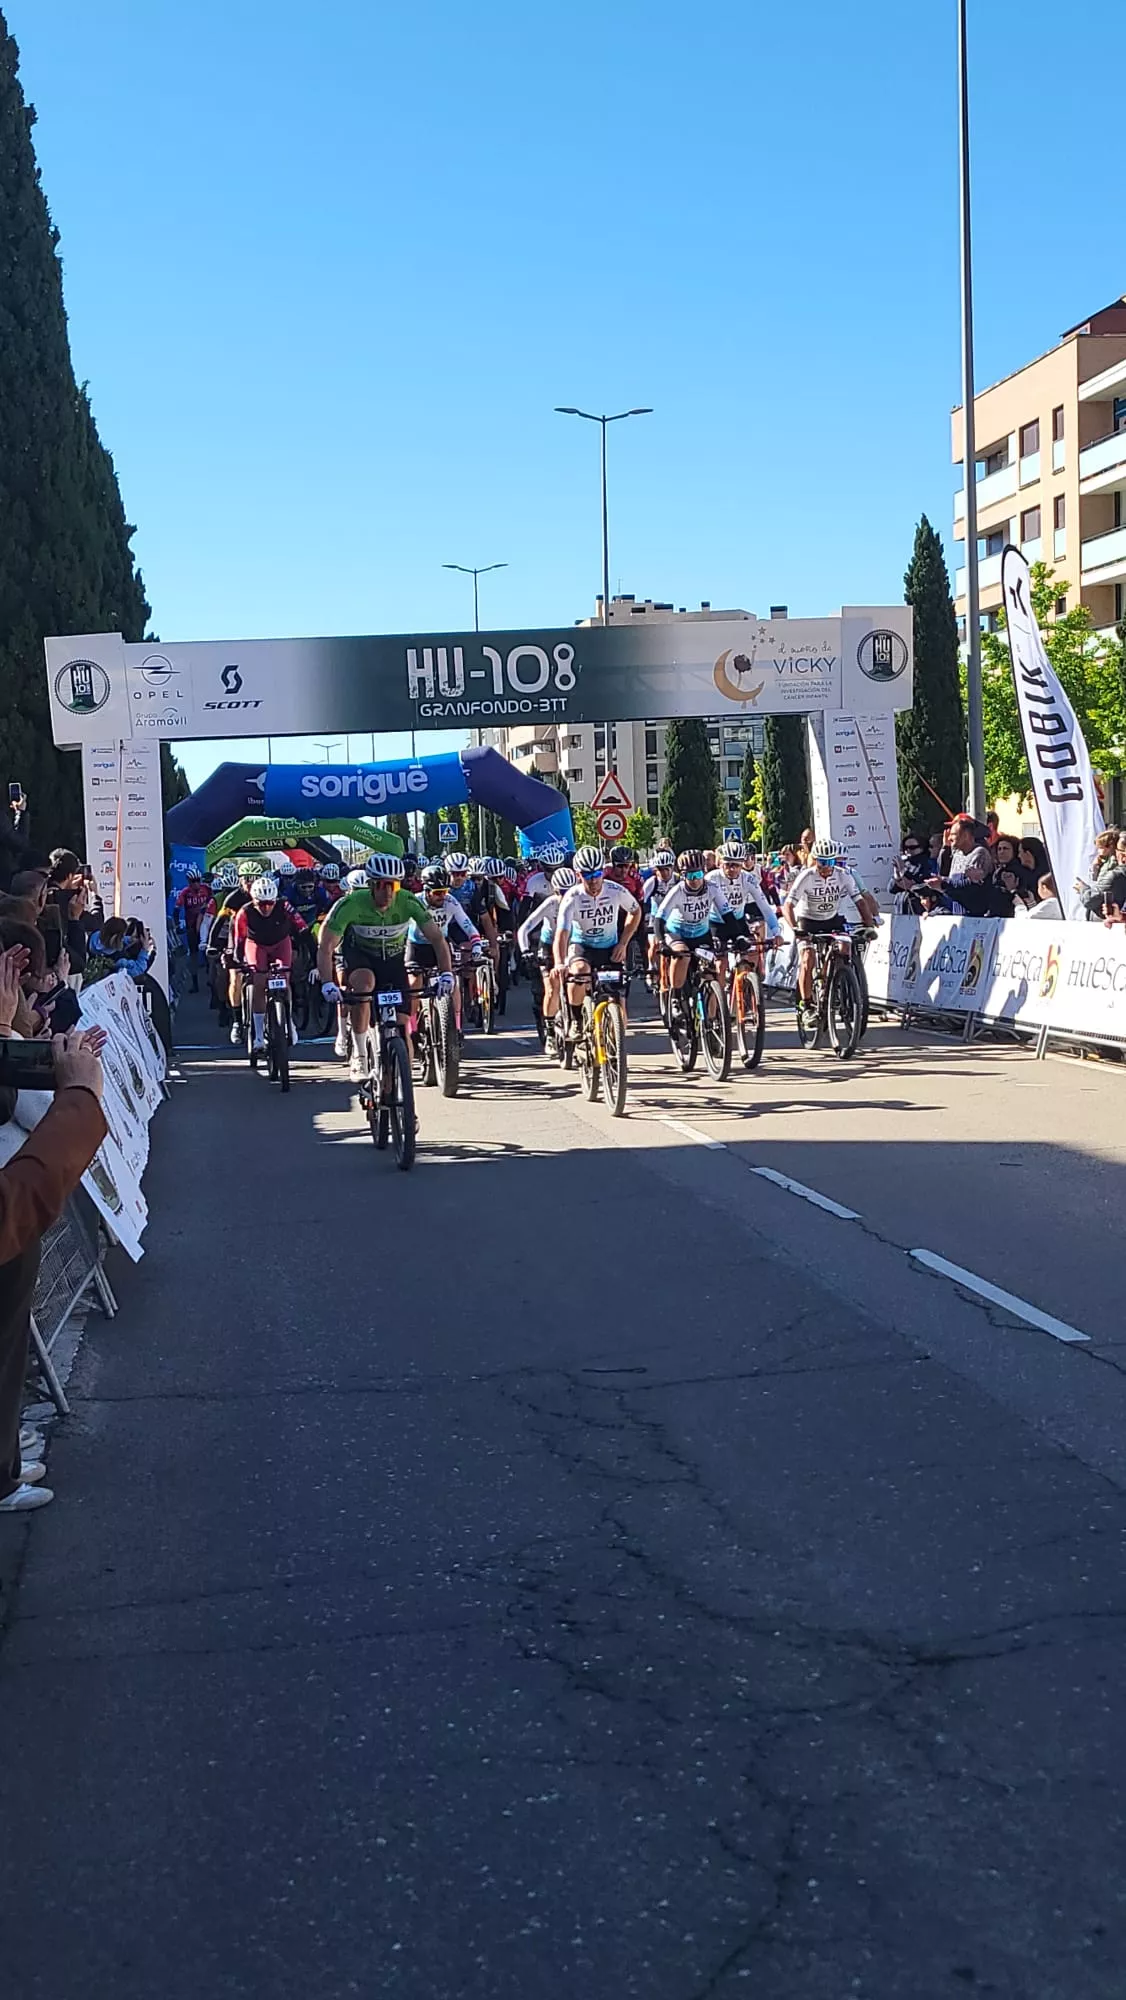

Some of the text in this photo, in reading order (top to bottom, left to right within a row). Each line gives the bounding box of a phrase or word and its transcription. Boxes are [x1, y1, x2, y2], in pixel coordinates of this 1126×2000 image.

[875, 639, 891, 653] HU
[73, 669, 90, 684] HU
[406, 643, 576, 699] HU-108
[133, 690, 184, 700] OPEL
[202, 700, 264, 710] SCOTT
[1018, 657, 1085, 803] GOBIK
[603, 819, 621, 831] 20
[239, 838, 283, 848] odoactiva
[813, 886, 840, 896] TEAM
[580, 905, 614, 919] TEAM
[683, 900, 709, 913] TEAM
[592, 915, 614, 927] 108
[1067, 956, 1126, 992] Huesc
